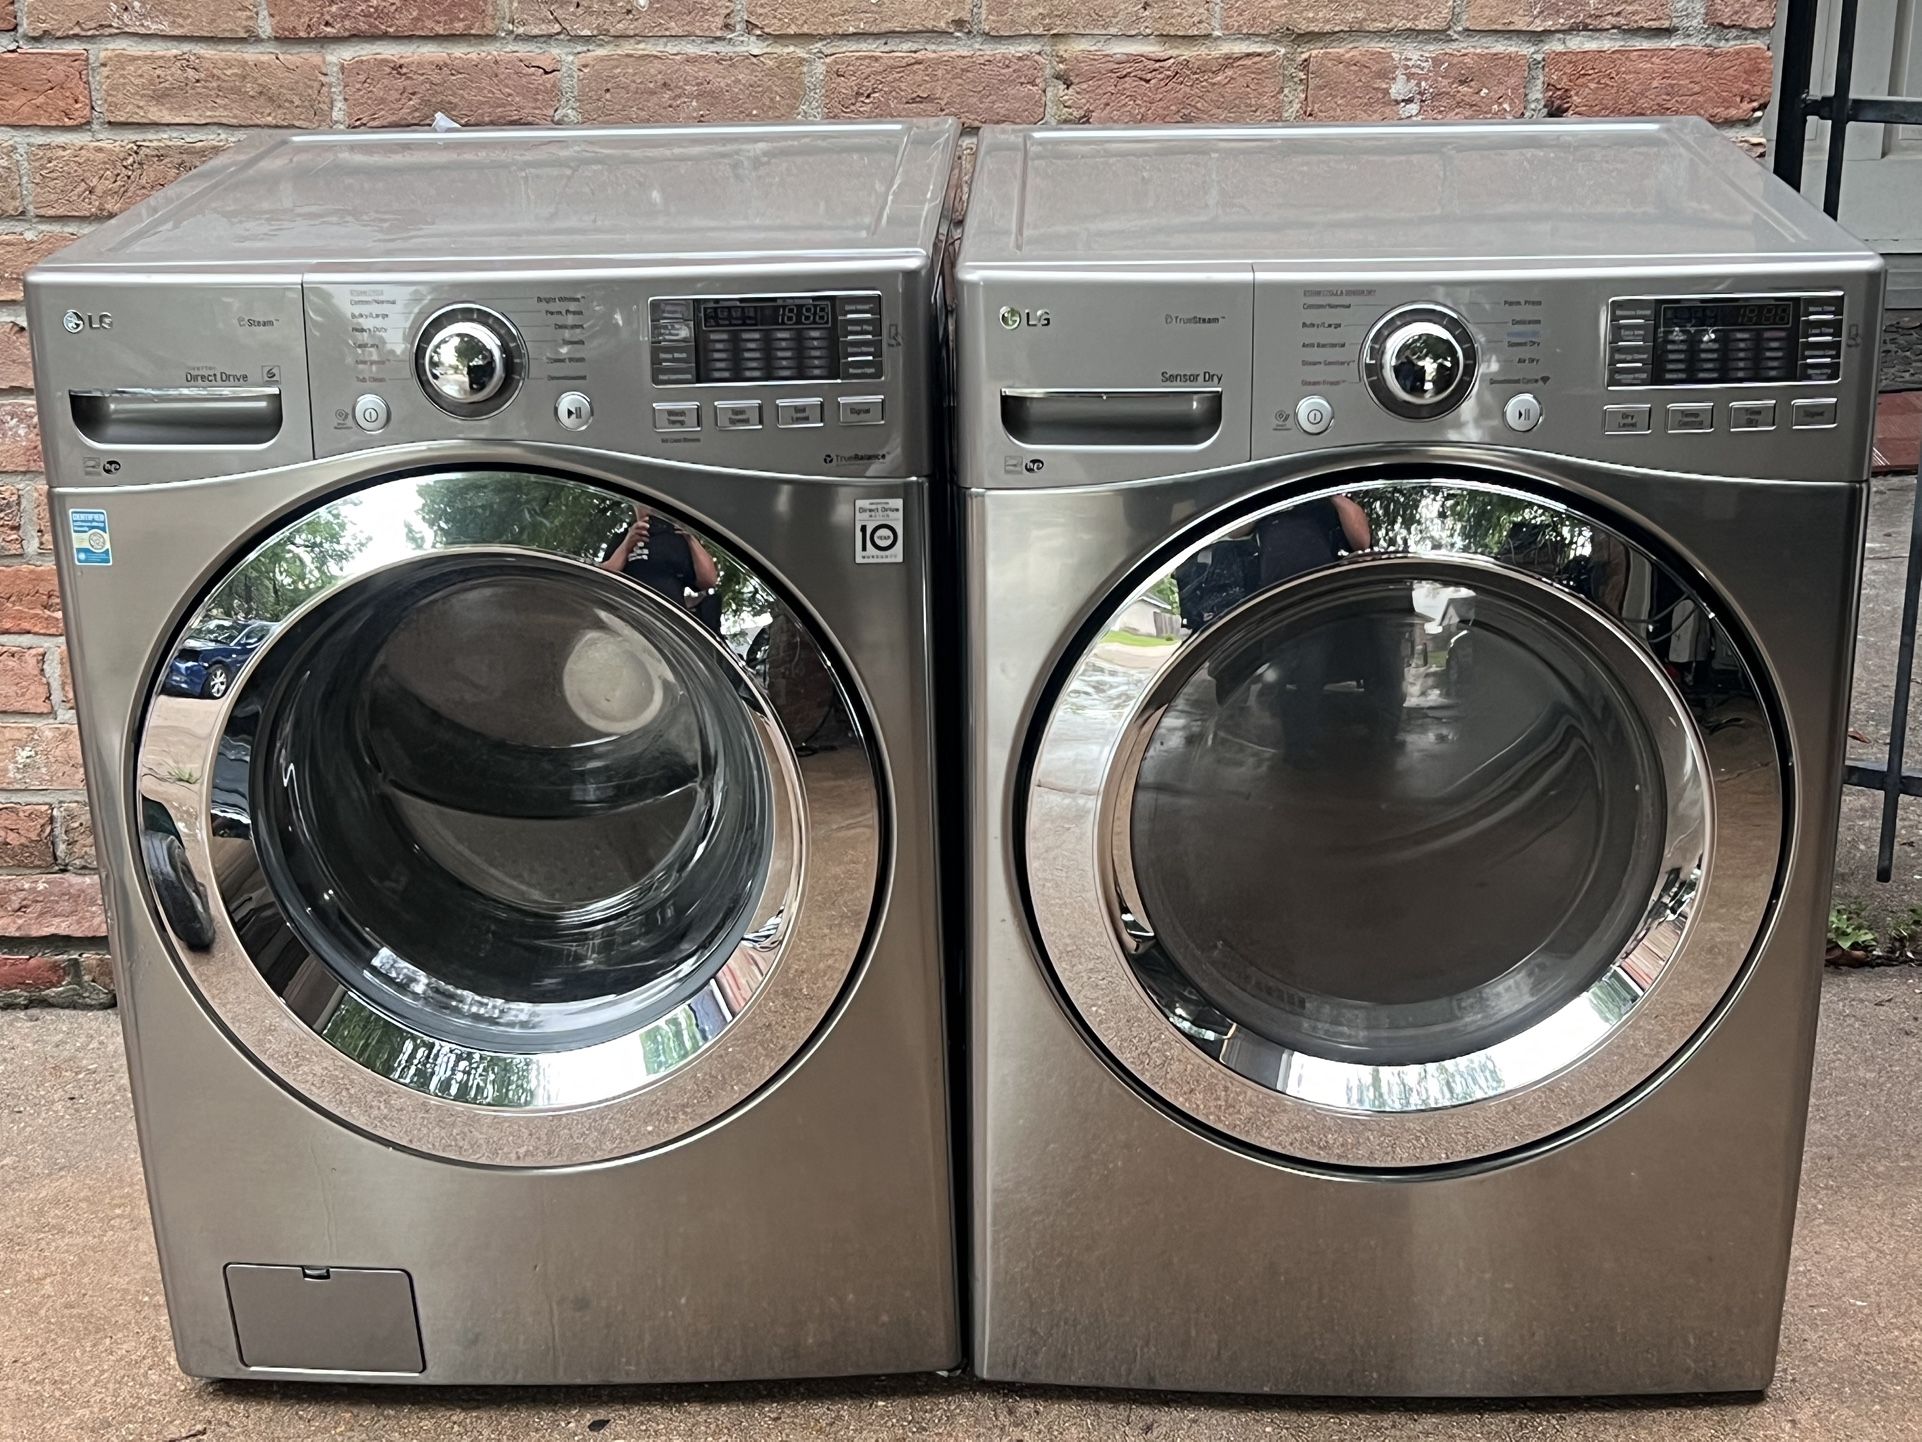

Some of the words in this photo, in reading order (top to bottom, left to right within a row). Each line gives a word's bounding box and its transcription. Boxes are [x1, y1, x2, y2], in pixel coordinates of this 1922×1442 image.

[87, 312, 113, 330] LG
[1026, 309, 1051, 327] LG
[185, 372, 218, 383] Direct
[220, 371, 249, 383] Drive
[1160, 371, 1200, 383] Sensor
[1203, 370, 1223, 385] Dry
[858, 506, 879, 514] Direct
[860, 523, 899, 553] 10
